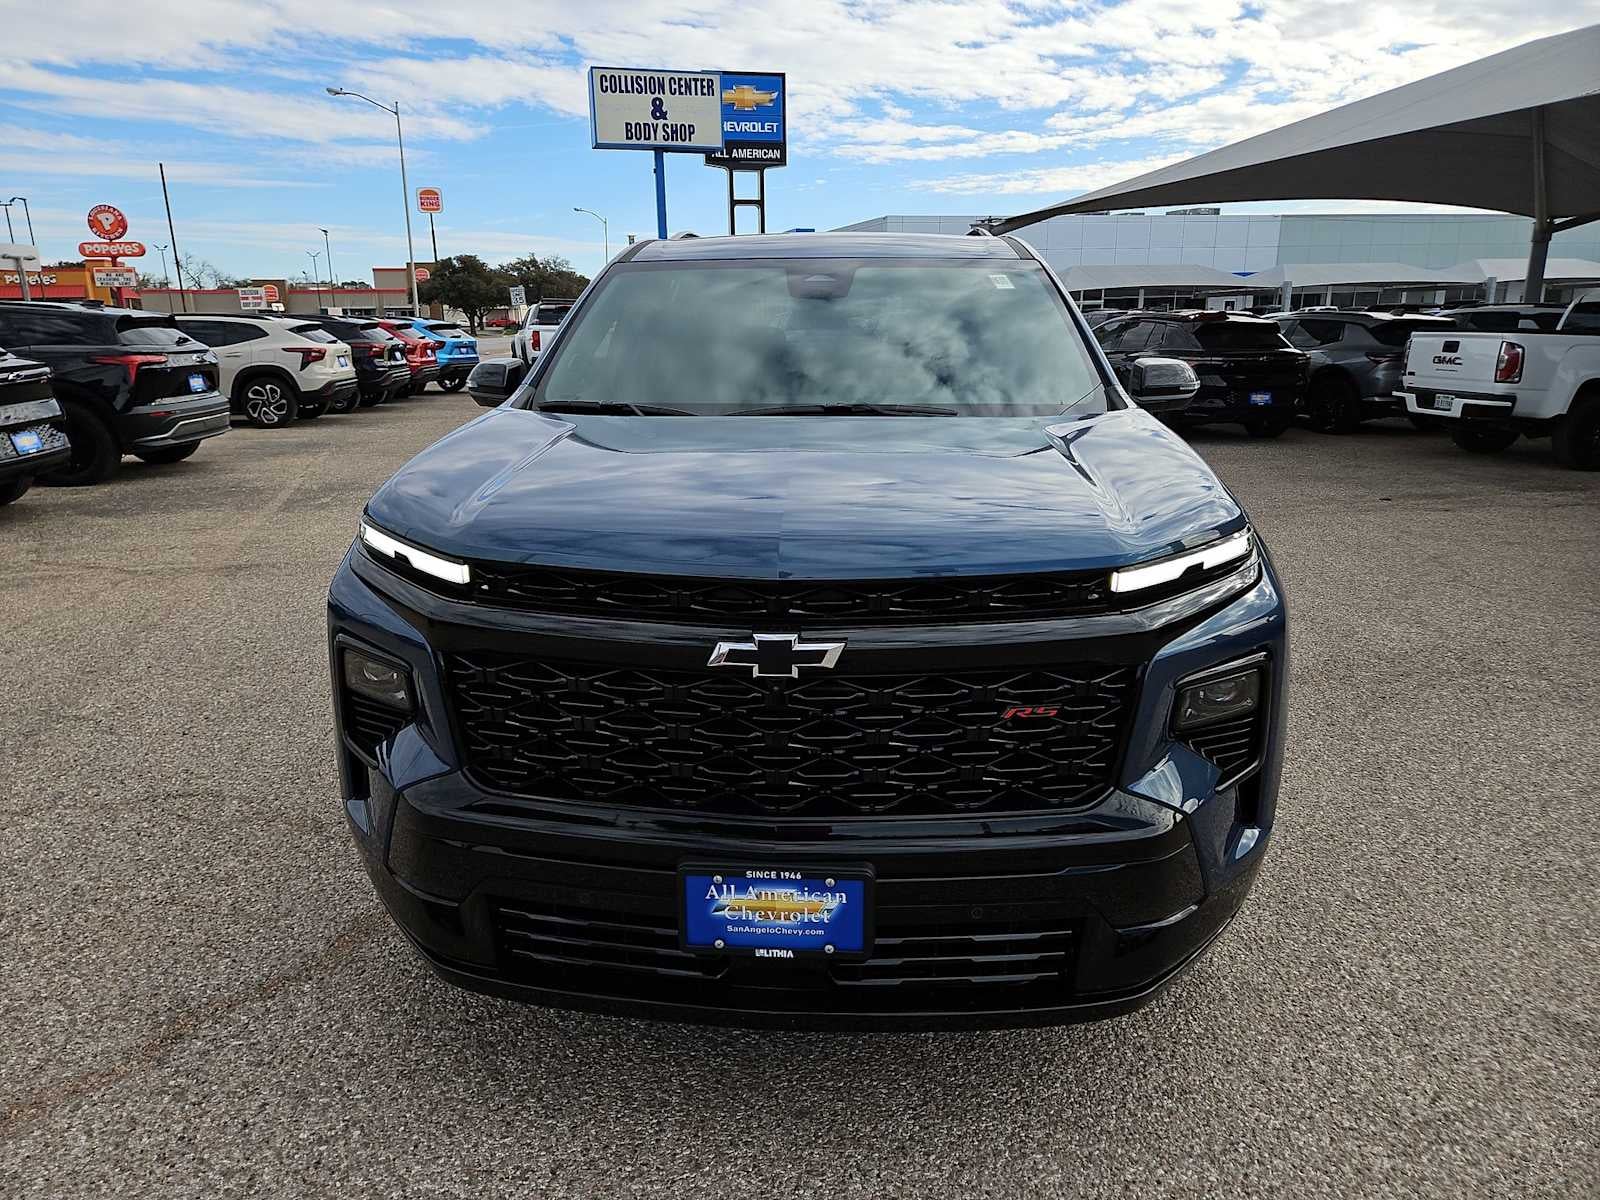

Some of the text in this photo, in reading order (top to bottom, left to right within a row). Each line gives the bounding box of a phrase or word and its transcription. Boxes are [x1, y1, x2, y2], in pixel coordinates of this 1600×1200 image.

[600, 74, 714, 97] COLLISION CENTER
[651, 97, 668, 120] &
[625, 122, 695, 142] BODY SHOP
[723, 121, 779, 133] EVROLET
[732, 149, 781, 159] AMERICAN
[1432, 355, 1464, 366] GMC
[1000, 706, 1058, 720] RS
[746, 870, 802, 880] SINCE 1946
[705, 884, 848, 904] All American
[724, 904, 831, 924] Chevrolet
[726, 925, 825, 937] SanAngeloChevy.com
